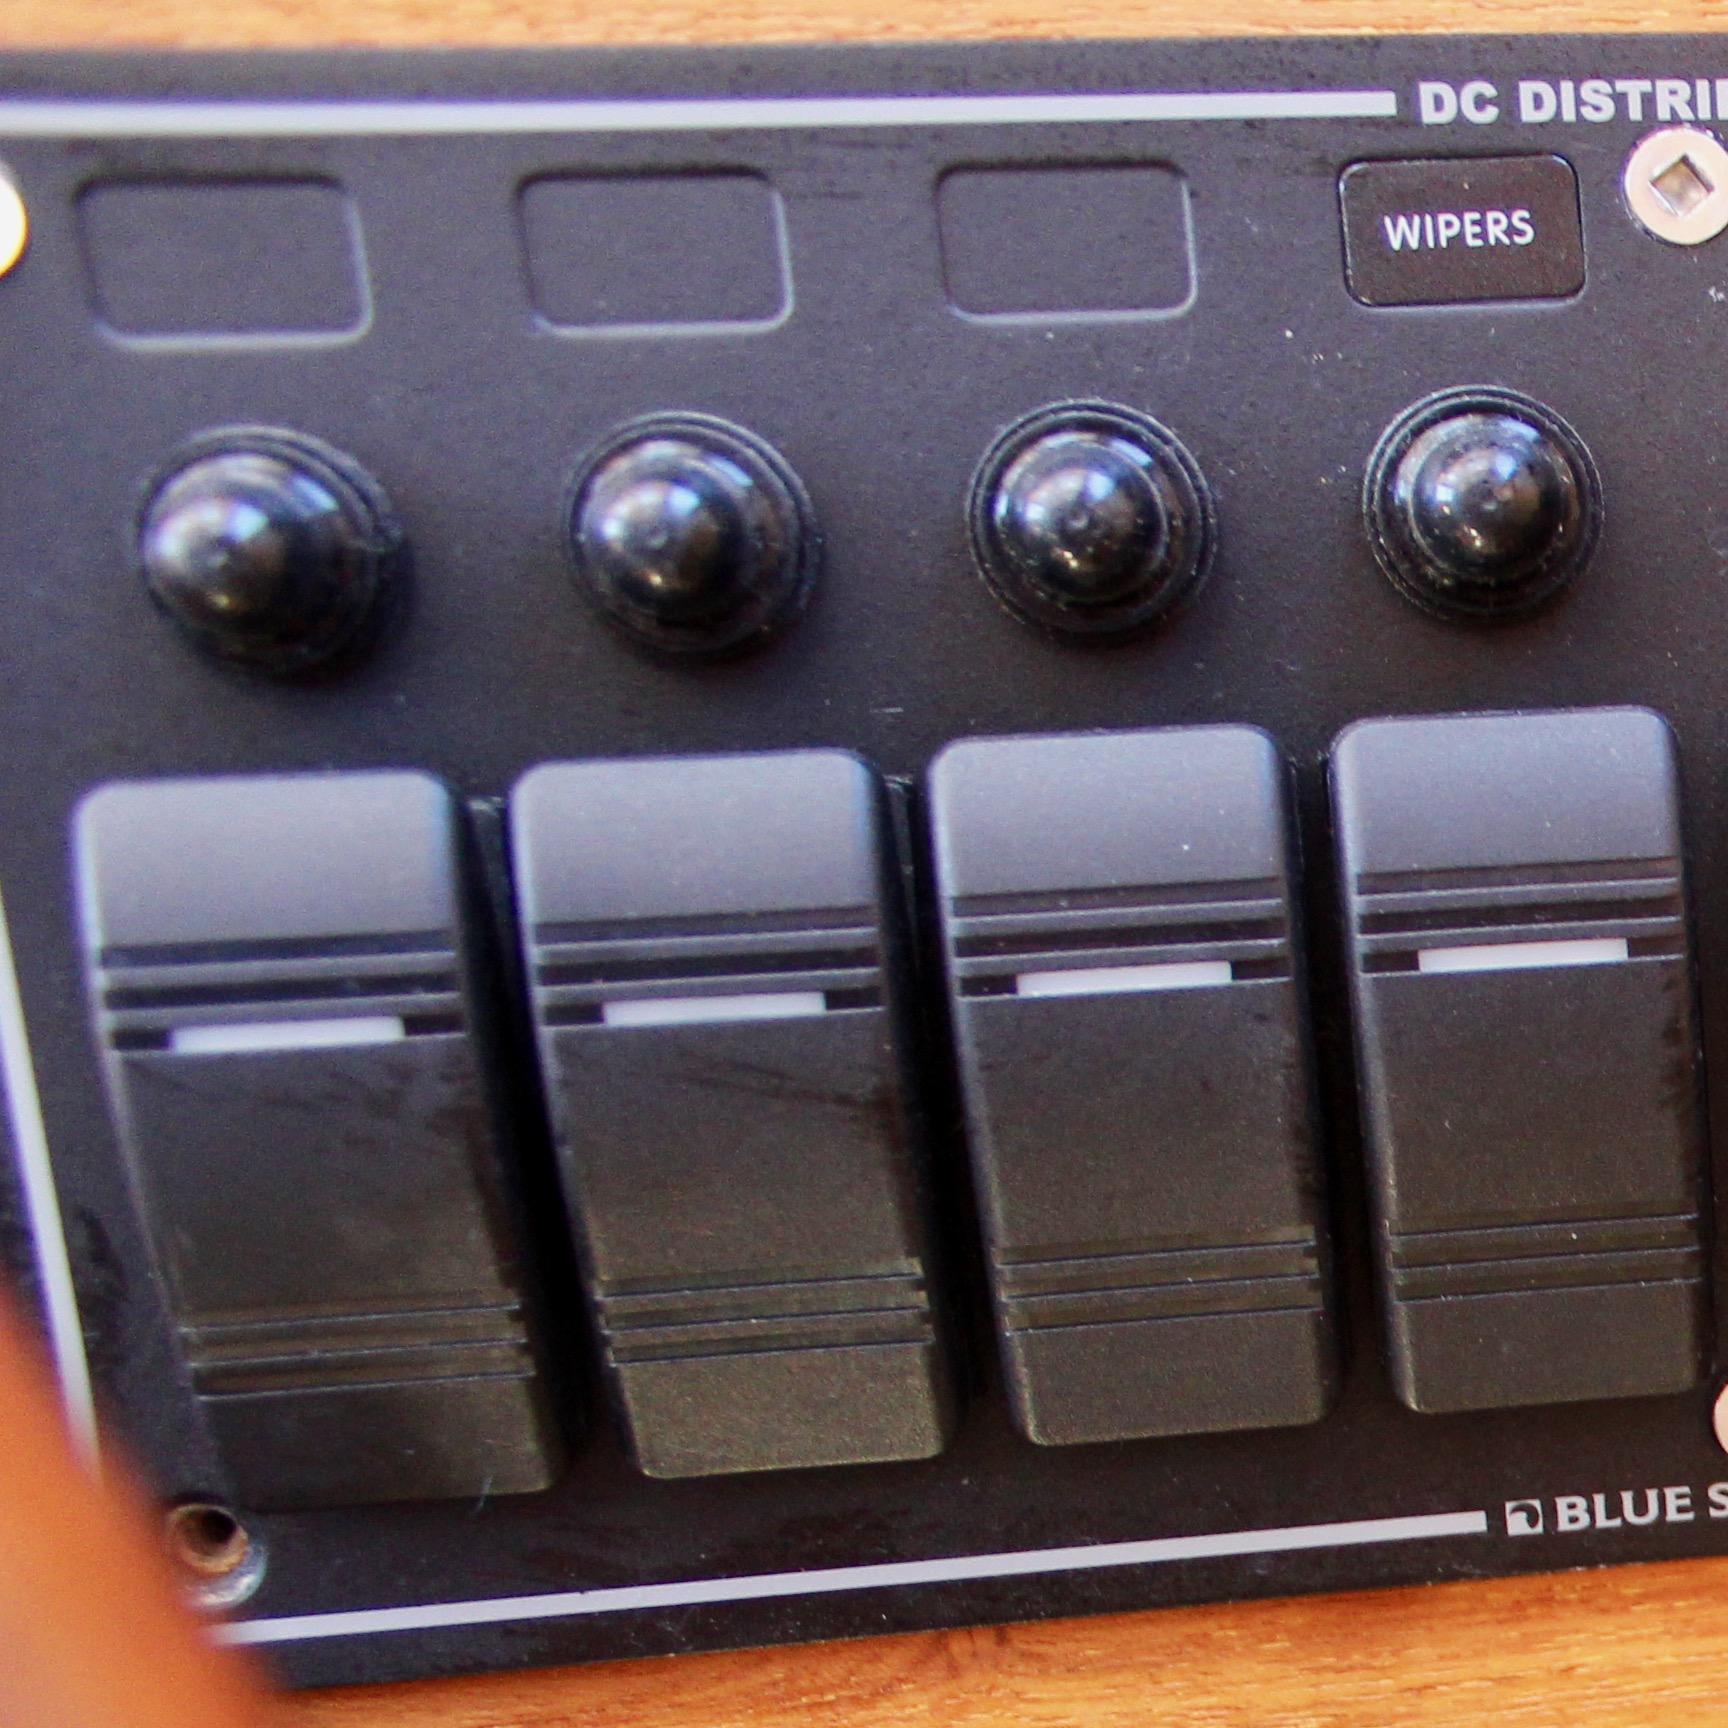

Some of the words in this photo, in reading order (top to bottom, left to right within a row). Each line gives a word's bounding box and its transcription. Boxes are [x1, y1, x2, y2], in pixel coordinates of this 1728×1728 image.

[1418, 80, 1500, 125] DC
[1382, 208, 1535, 252] WIPERS
[1554, 1485, 1695, 1534] BLUE
